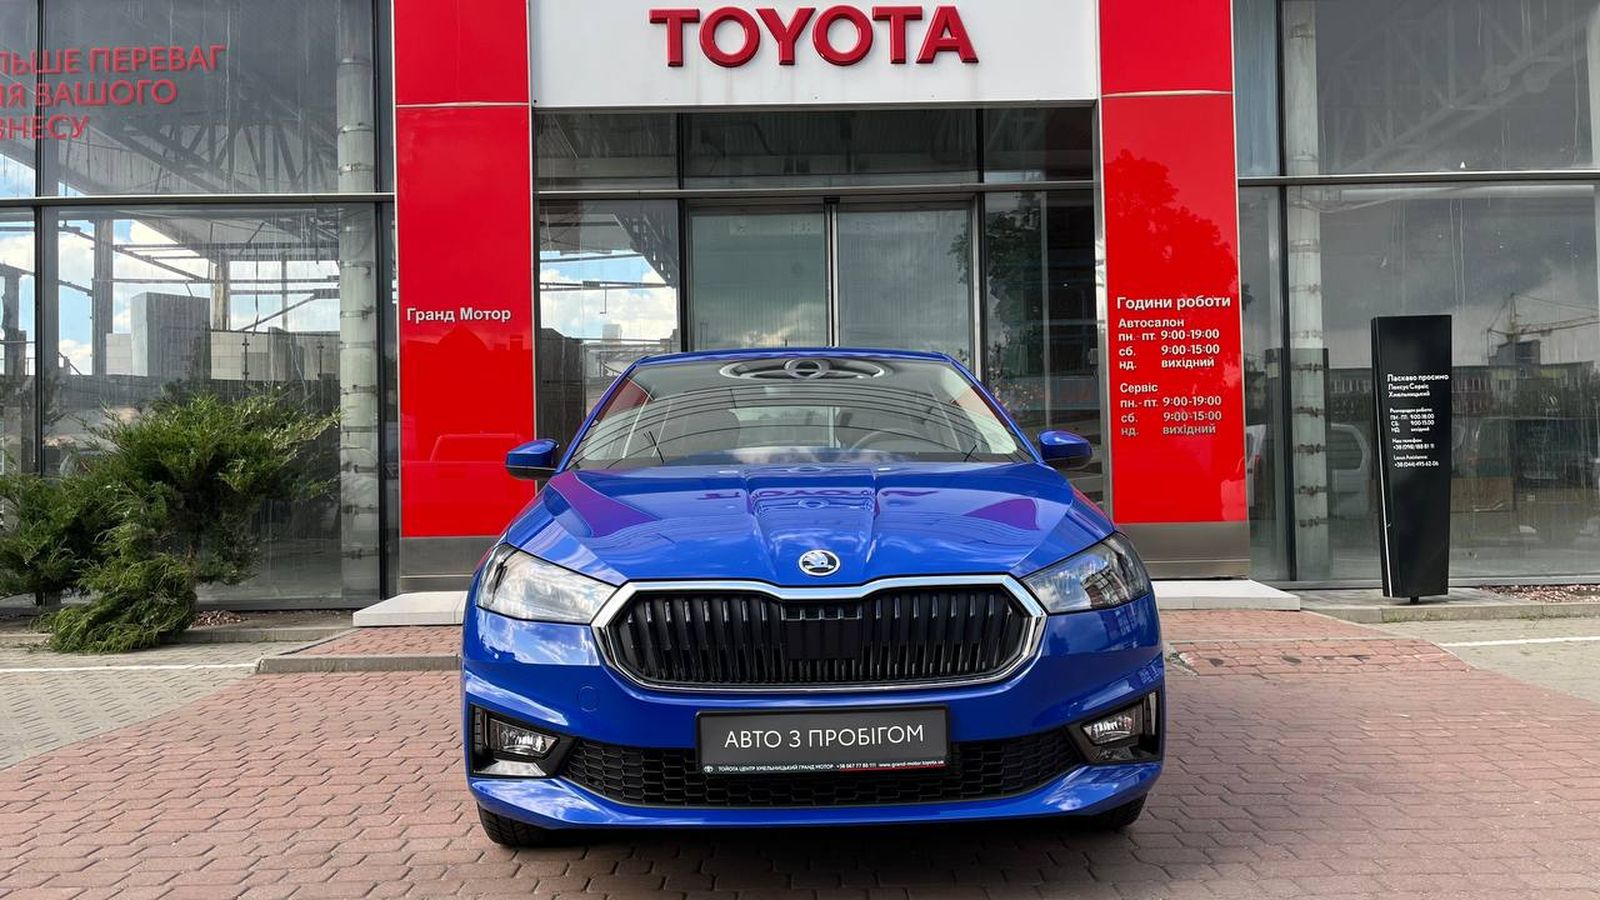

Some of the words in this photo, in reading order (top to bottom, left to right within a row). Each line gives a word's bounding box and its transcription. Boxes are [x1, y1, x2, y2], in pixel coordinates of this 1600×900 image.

[649, 5, 979, 68] TOYOTA
[89, 45, 227, 74] ПЕРЕВАГ
[36, 79, 177, 107] ВАШОГО
[1117, 297, 1172, 310] Години
[1177, 295, 1231, 310] роботи
[407, 308, 455, 324] Гранд
[460, 307, 511, 323] Мотор
[1118, 318, 1184, 328] Автосалон
[1161, 329, 1220, 340] 9:00-19:00
[1119, 346, 1136, 356] сб.
[1161, 344, 1220, 355] 9:00-15:00
[1119, 360, 1137, 370] нд.
[1161, 356, 1215, 368] вихідний
[1418, 374, 1449, 382] просимо
[1120, 382, 1158, 394] Сервіс
[1162, 395, 1222, 406] 9:00-19:00
[1121, 413, 1138, 423] сб.
[1121, 427, 1139, 437] нд.
[1163, 423, 1216, 435] вихідний
[724, 730, 782, 748] АВТО
[788, 730, 801, 747] З
[809, 725, 925, 748] ПРОБІГОМ
